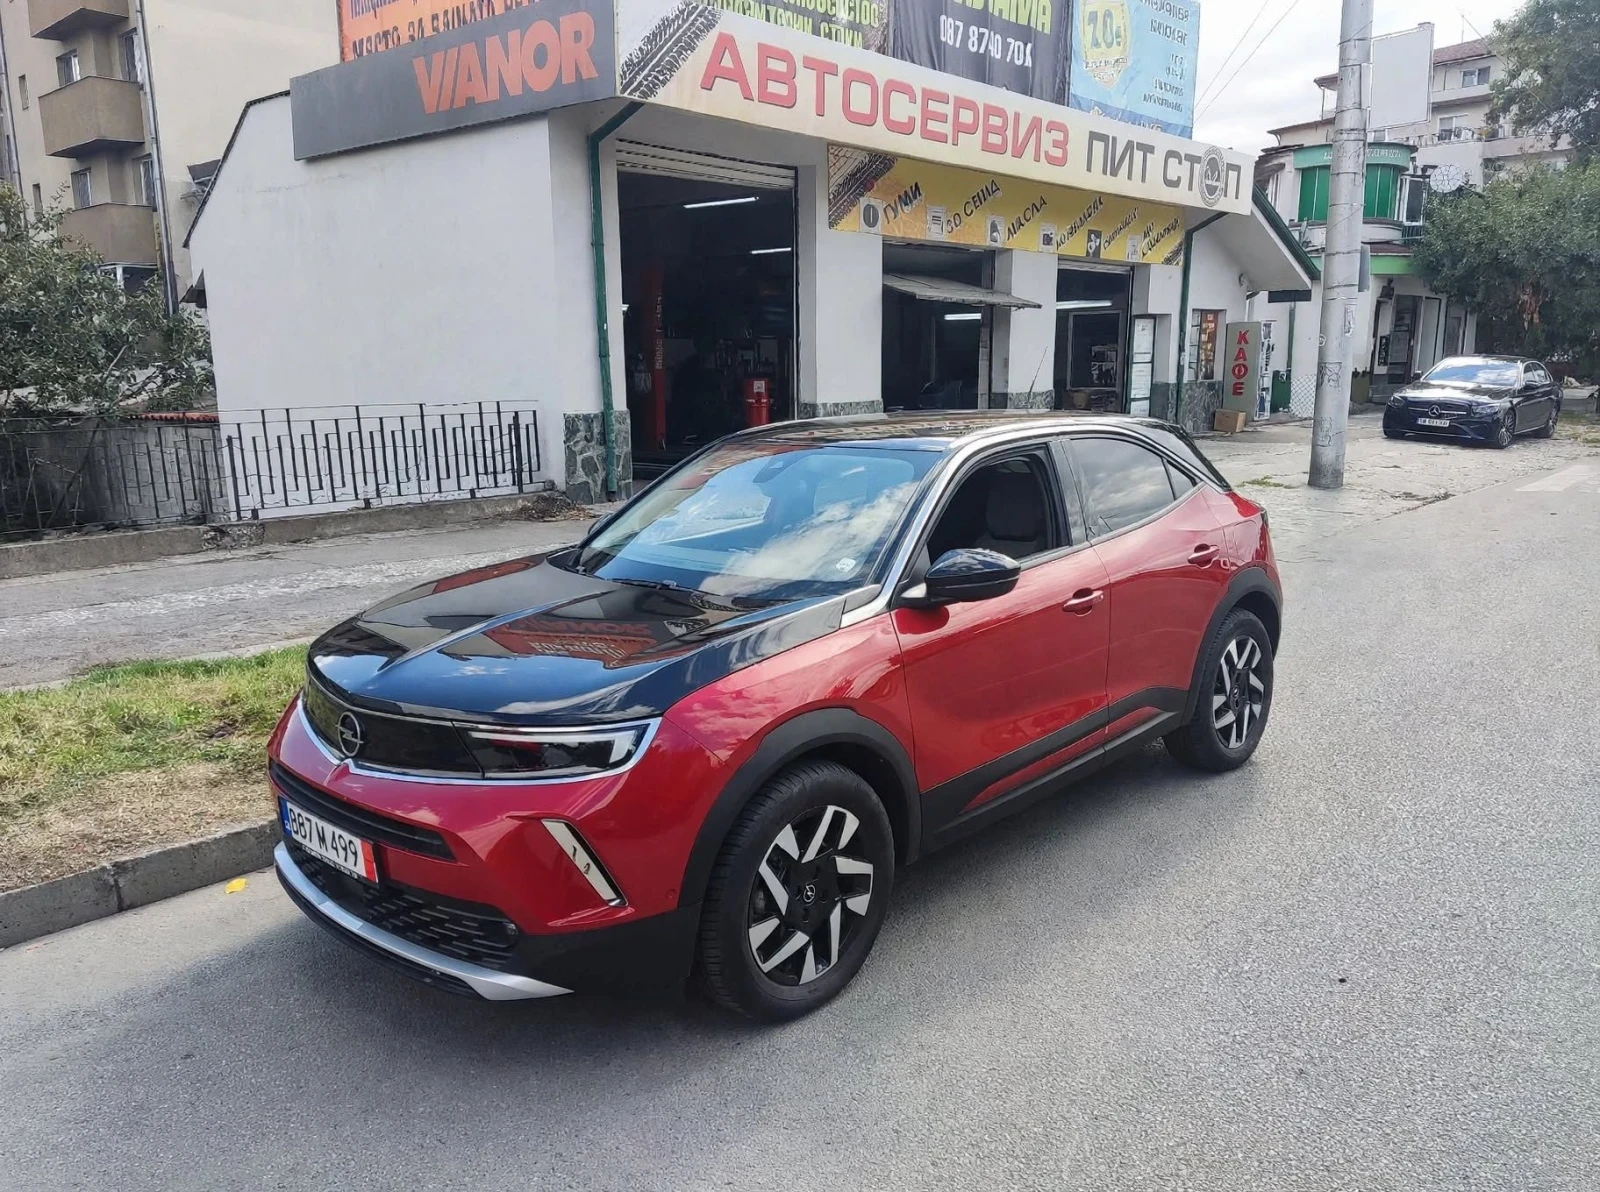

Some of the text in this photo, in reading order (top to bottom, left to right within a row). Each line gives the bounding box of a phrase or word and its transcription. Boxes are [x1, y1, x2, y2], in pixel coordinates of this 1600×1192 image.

[939, 14, 964, 49] 087
[967, 25, 1002, 60] 8740
[412, 11, 598, 114] VIANOR
[701, 32, 1241, 208] АВТОСЕРВИЗ ПИТ СТОП
[1006, 194, 1049, 242] МАСЛА
[315, 820, 329, 853] M
[330, 830, 358, 867] 499
